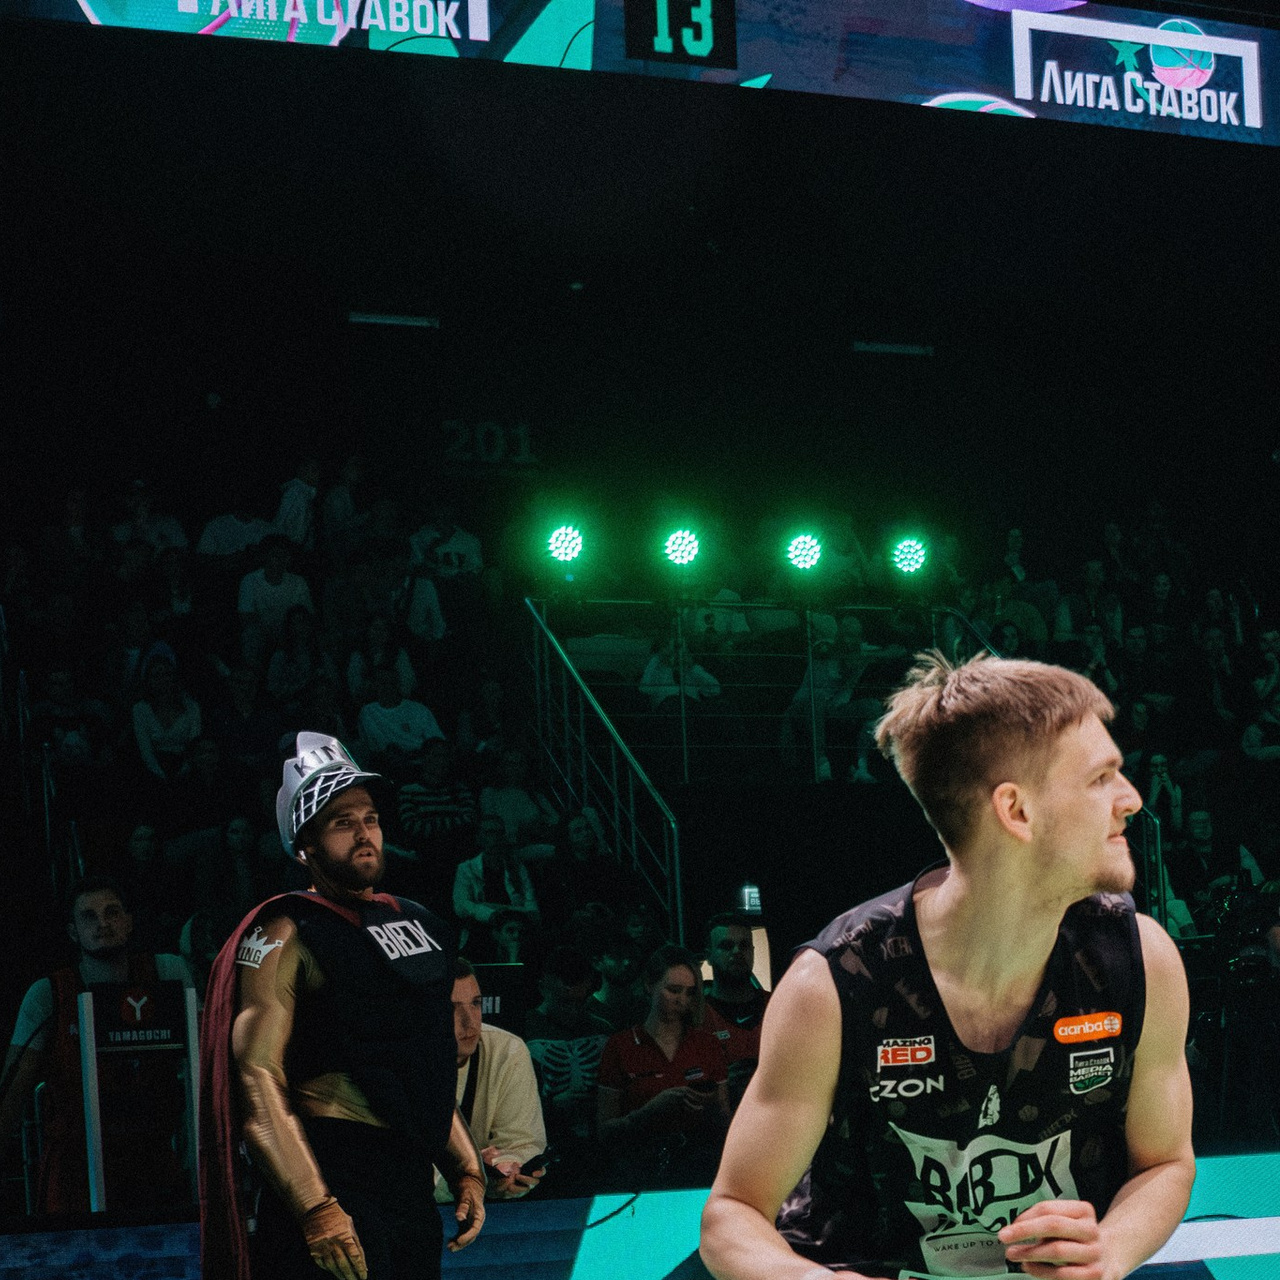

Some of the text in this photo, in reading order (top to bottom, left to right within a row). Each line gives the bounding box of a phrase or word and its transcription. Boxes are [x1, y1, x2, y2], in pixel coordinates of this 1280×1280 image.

[1040, 59, 1240, 125] ЛИГА СТАВОК
[441, 420, 539, 465] 201
[238, 947, 262, 963] ING
[108, 1029, 171, 1042] YAMAGUCHI
